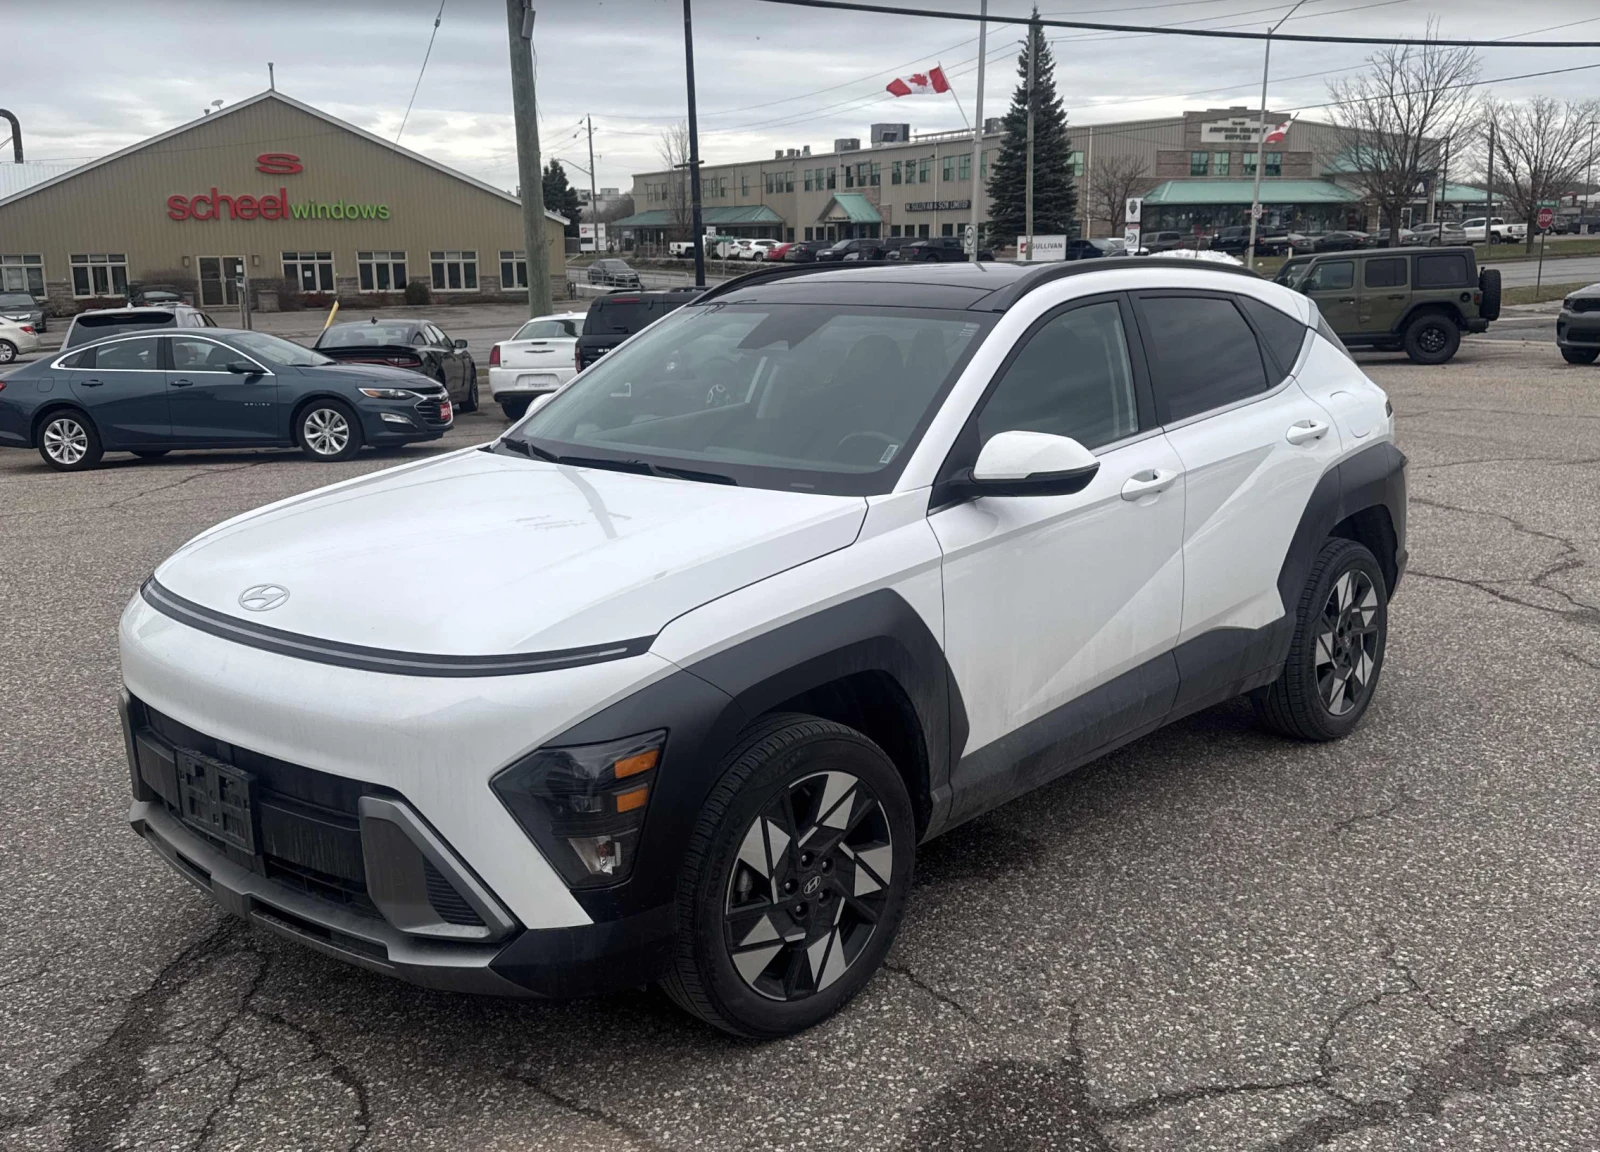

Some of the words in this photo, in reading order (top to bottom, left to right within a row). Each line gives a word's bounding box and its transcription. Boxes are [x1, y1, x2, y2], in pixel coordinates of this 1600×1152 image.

[168, 187, 289, 220] scheel
[290, 199, 390, 220] windows
[912, 202, 933, 210] SULLIVAN
[938, 201, 949, 209] SON
[950, 201, 968, 209] LIMITED
[1539, 213, 1552, 222] STOP
[703, 813, 743, 905] KUMHO
